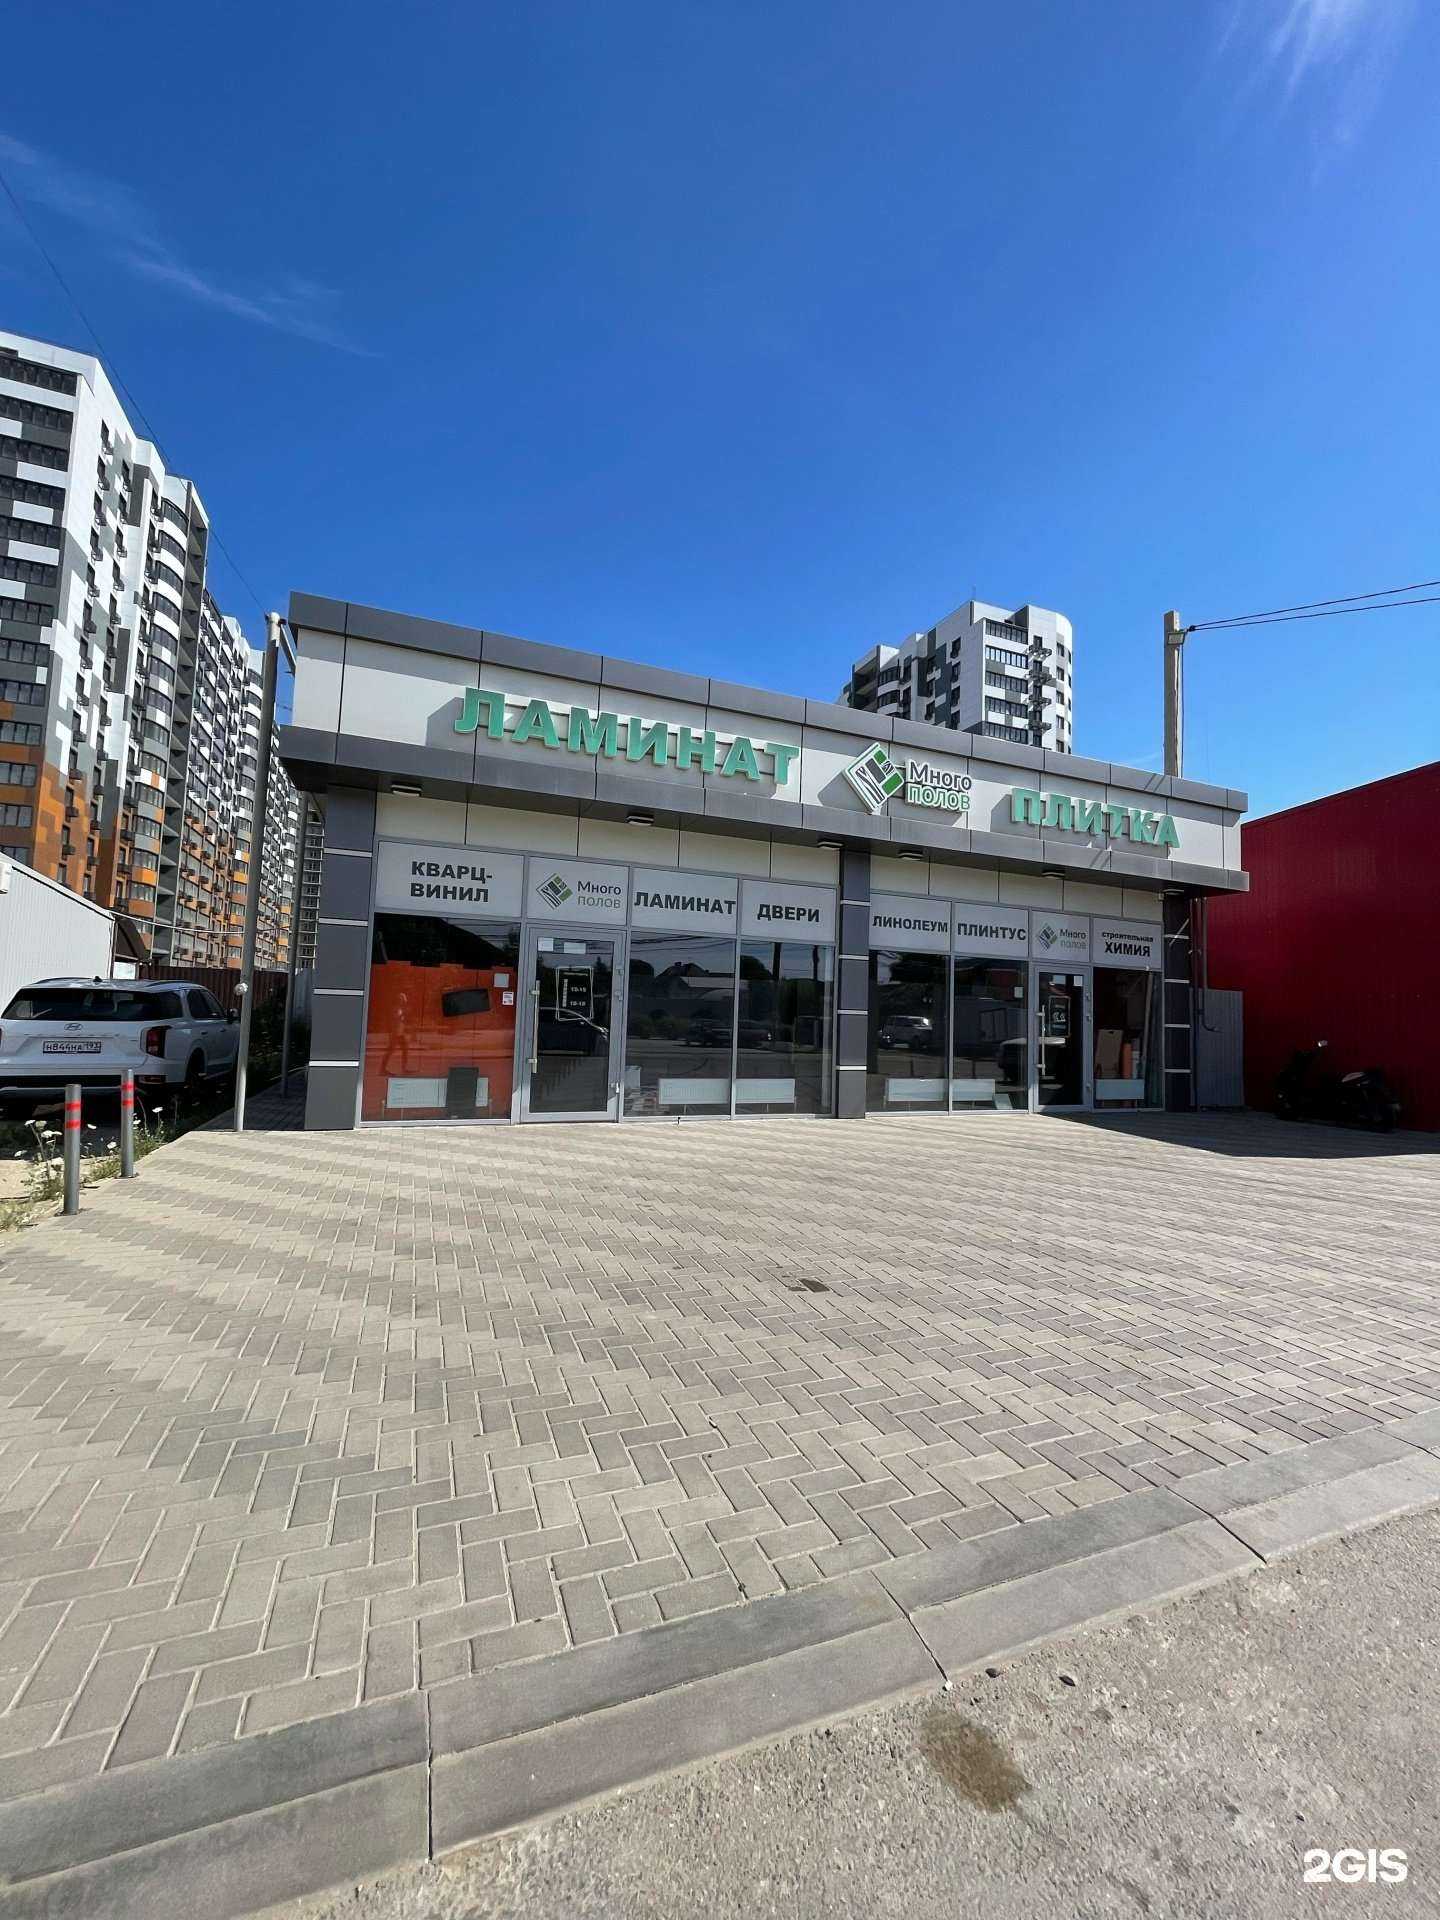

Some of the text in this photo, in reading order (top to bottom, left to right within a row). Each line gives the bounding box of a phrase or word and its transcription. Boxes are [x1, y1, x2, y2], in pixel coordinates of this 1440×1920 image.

[453, 687, 800, 785] ЛАМИНАТ
[909, 760, 972, 791] Много
[1011, 788, 1181, 849] ПЛИТКА
[411, 861, 493, 884] КВАРЦ-
[410, 882, 489, 902] ВИНИЛ
[577, 880, 622, 895] Много
[634, 892, 737, 914] ЛАМИНАТ
[757, 904, 820, 922] ДВЕРИ
[872, 915, 948, 933] ЛИНОЛЕУМ
[957, 923, 1026, 941] ПЛИНТУС
[1060, 928, 1086, 939] Много
[1105, 941, 1150, 956] ХИМИЯ
